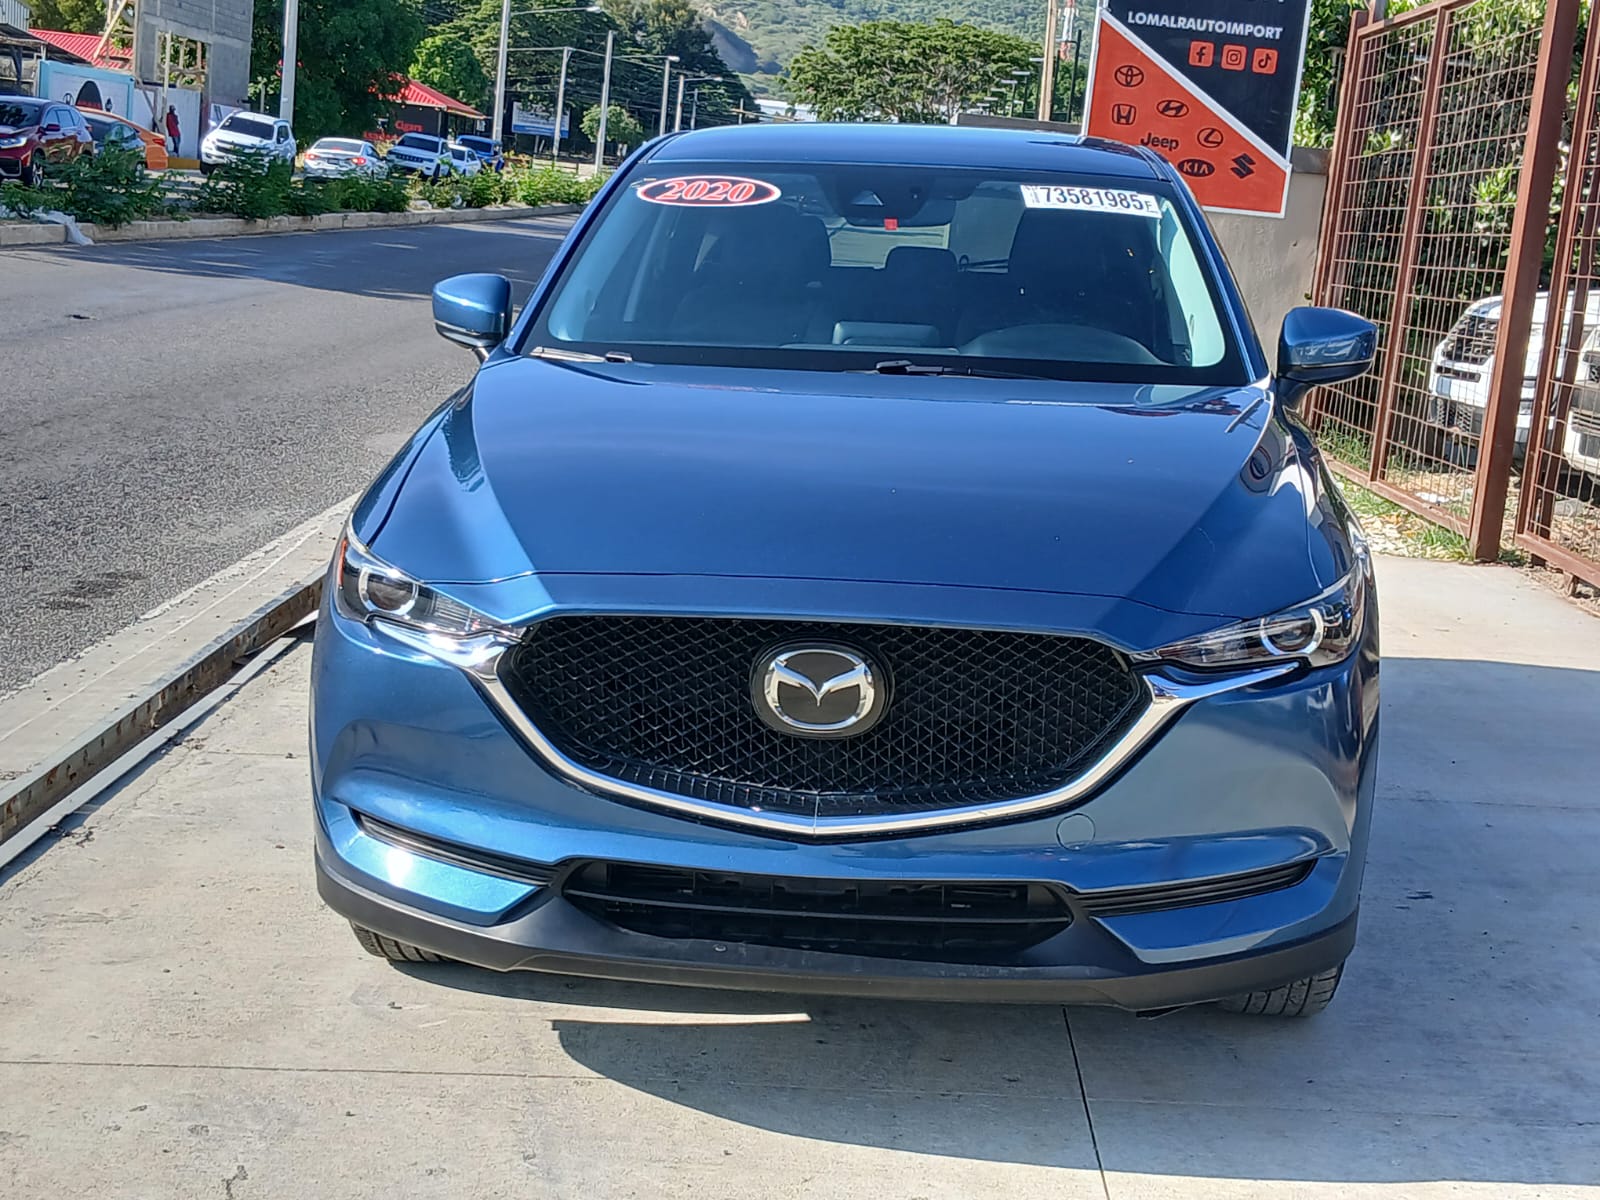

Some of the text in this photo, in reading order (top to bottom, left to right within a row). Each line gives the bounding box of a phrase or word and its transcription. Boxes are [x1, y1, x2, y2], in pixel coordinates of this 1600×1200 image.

[1128, 11, 1283, 39] LOMALRAUTOIMPORT
[1140, 132, 1179, 151] Jeep
[1183, 161, 1209, 174] KIA
[656, 180, 756, 202] 2020
